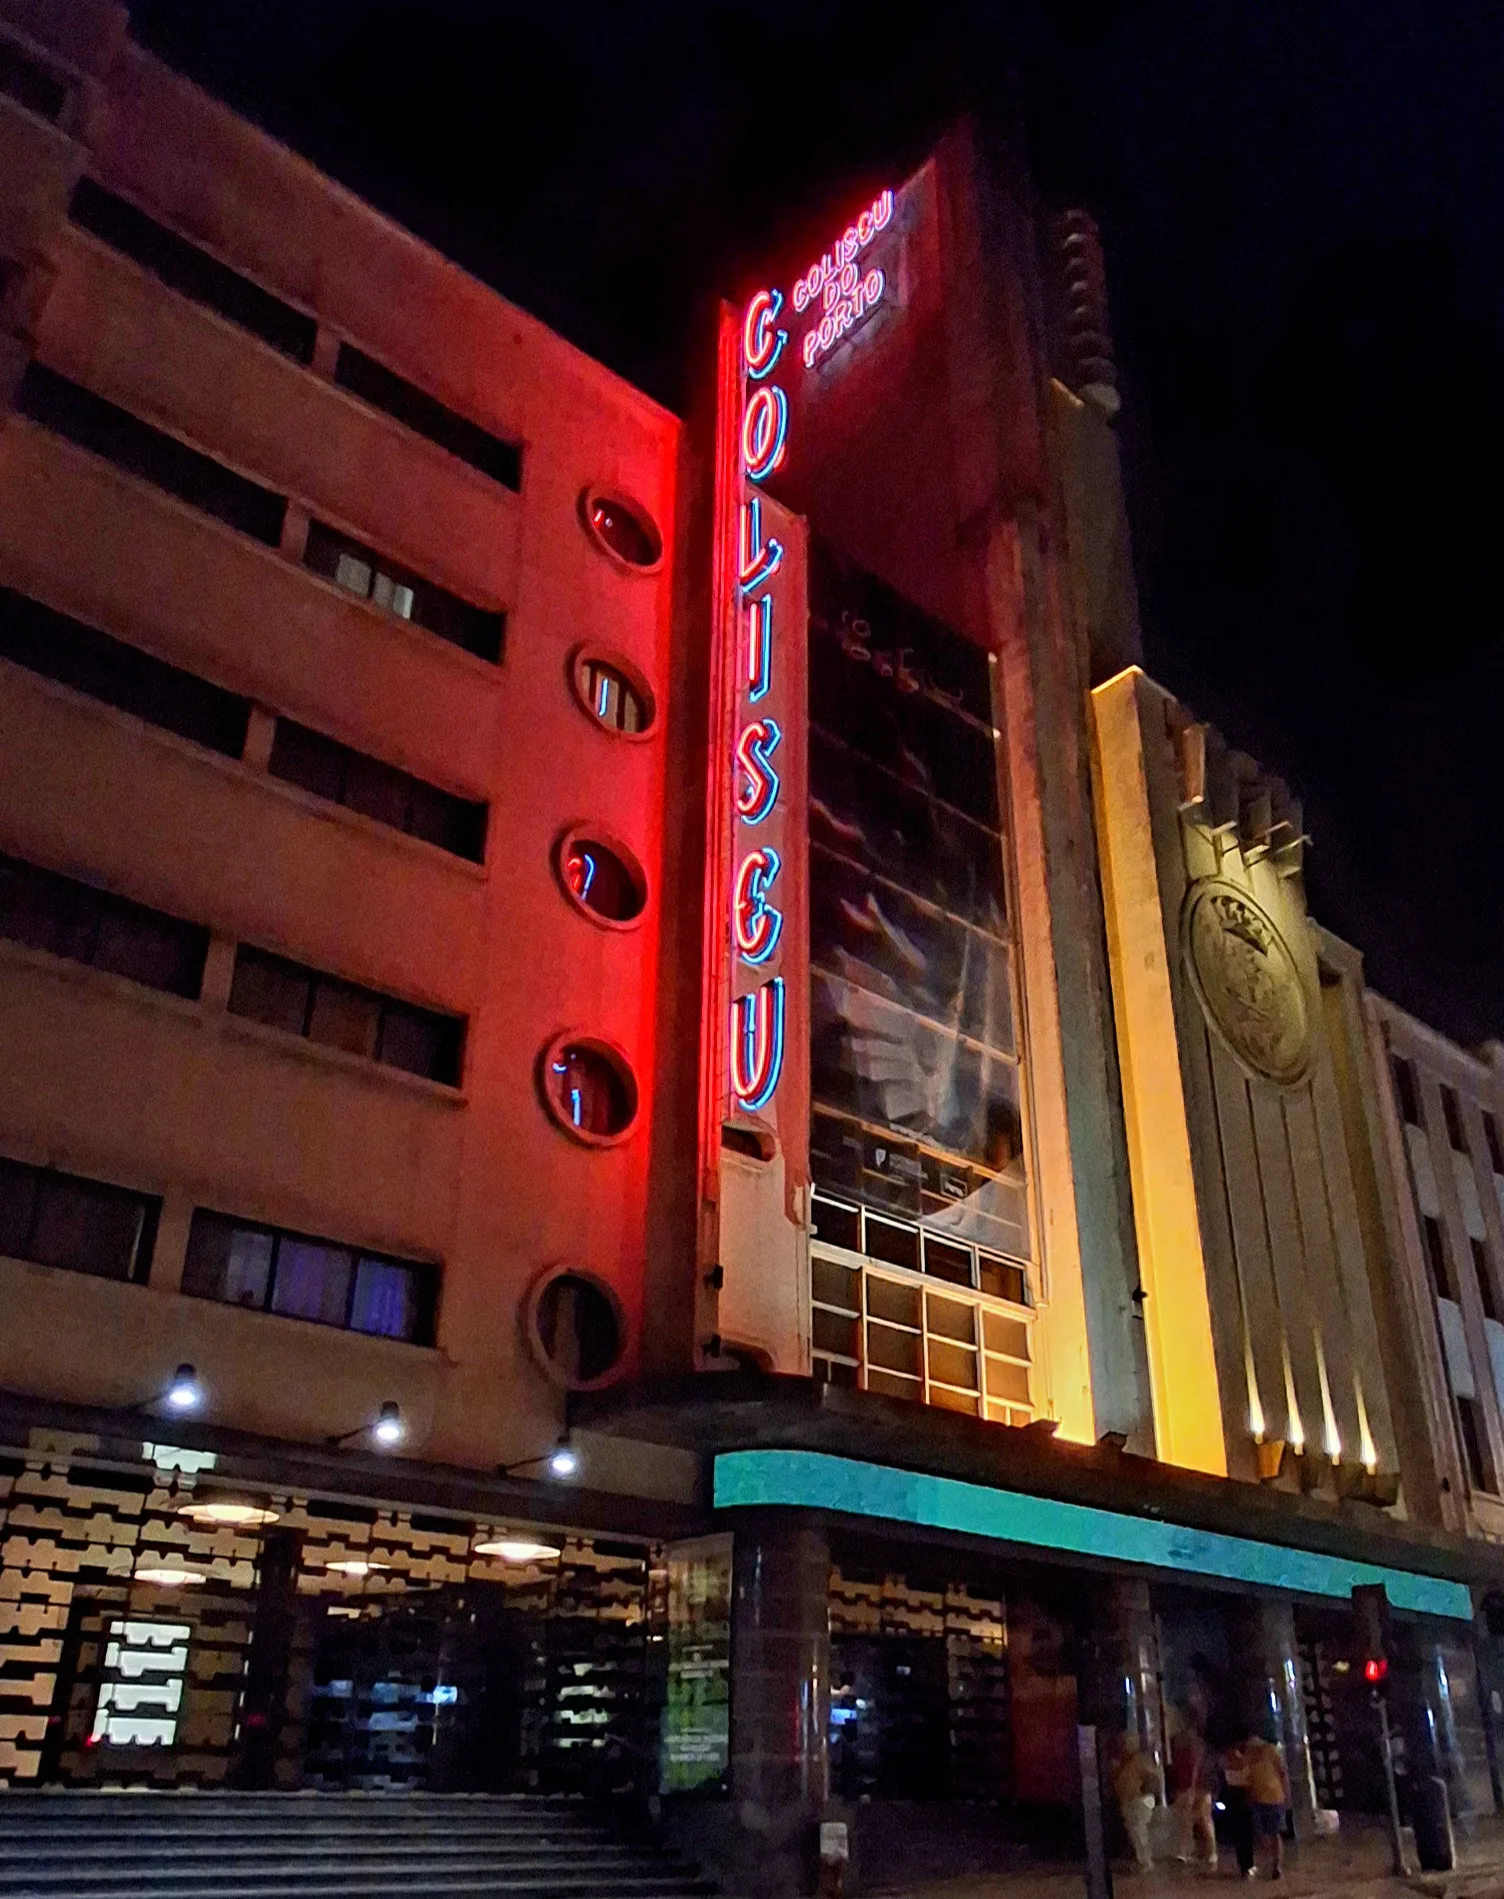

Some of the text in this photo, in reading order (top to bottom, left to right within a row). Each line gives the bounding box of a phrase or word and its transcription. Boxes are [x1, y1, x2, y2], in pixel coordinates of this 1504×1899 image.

[792, 190, 893, 312] COLISEU
[823, 262, 858, 316] DO
[803, 268, 884, 368] PORTO
[730, 288, 789, 1112] COLISEU
